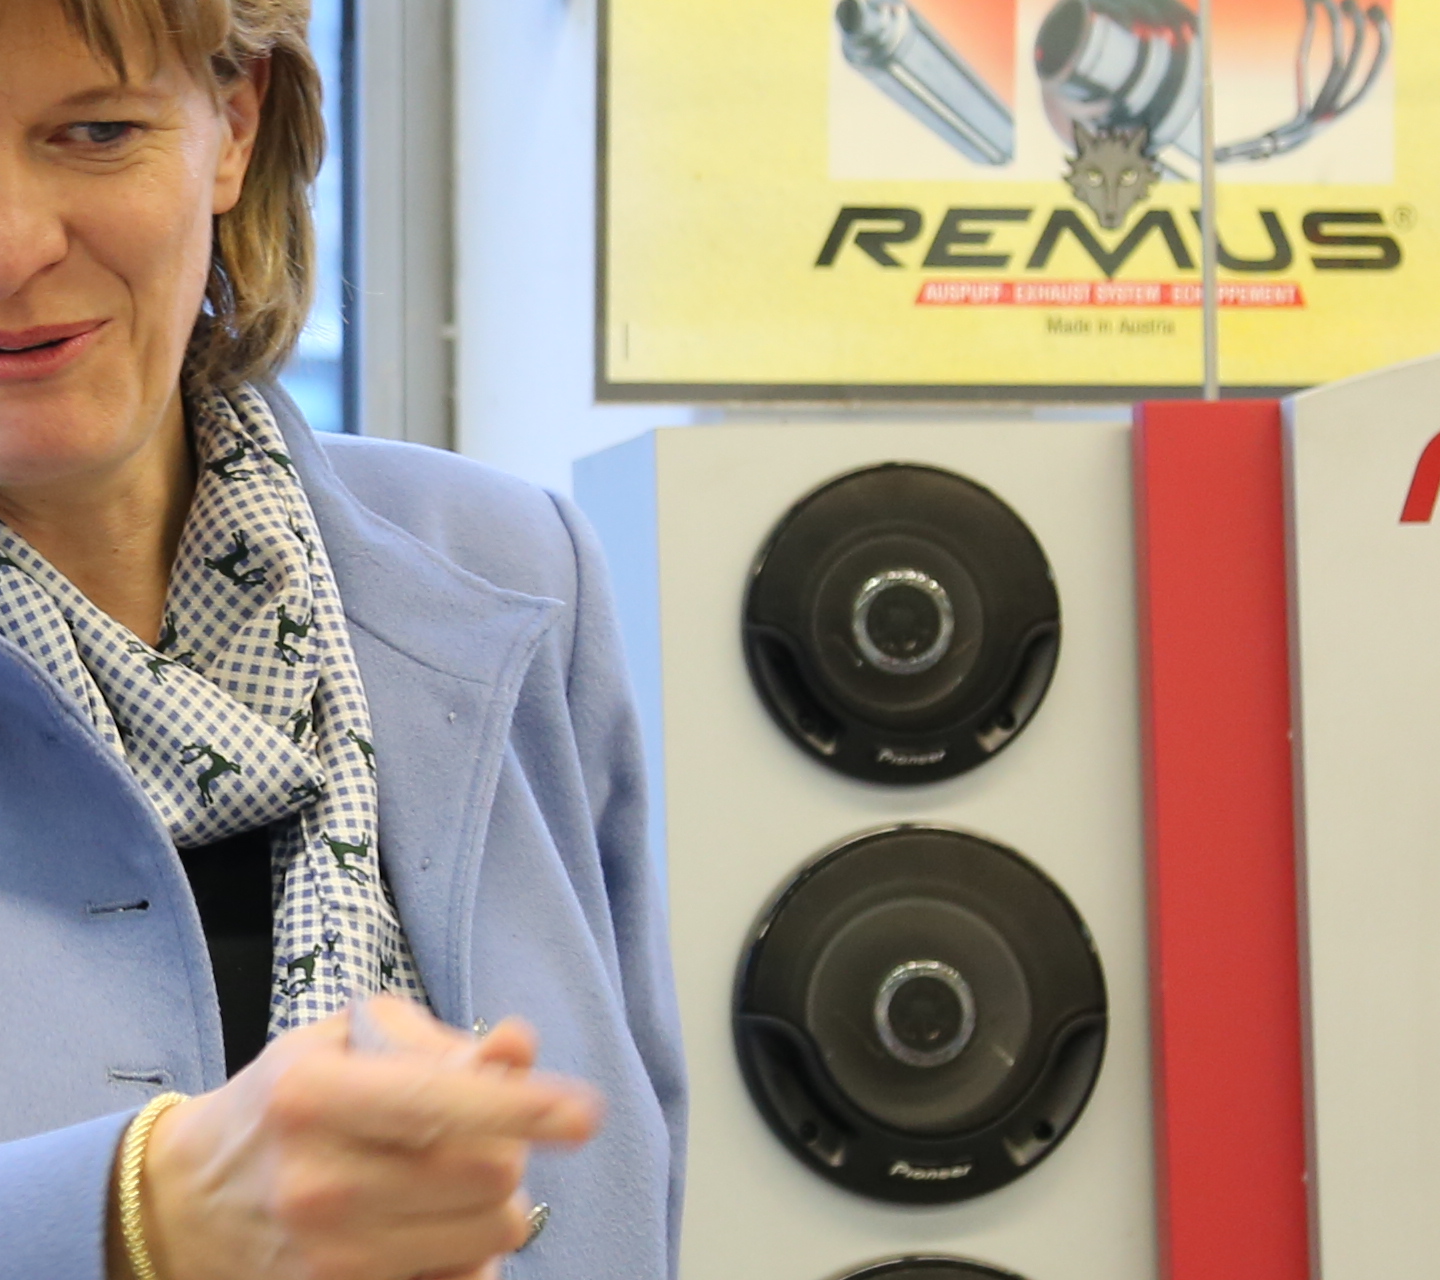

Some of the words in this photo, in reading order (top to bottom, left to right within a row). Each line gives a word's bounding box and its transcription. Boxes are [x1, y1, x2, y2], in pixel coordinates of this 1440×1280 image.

[814, 206, 1403, 279] REMUS
[1096, 283, 1162, 304] SYSTEM
[1046, 316, 1091, 335] Made
[1099, 316, 1113, 335] in
[1120, 316, 1175, 335] Austria
[889, 1160, 972, 1180] Pioneer
